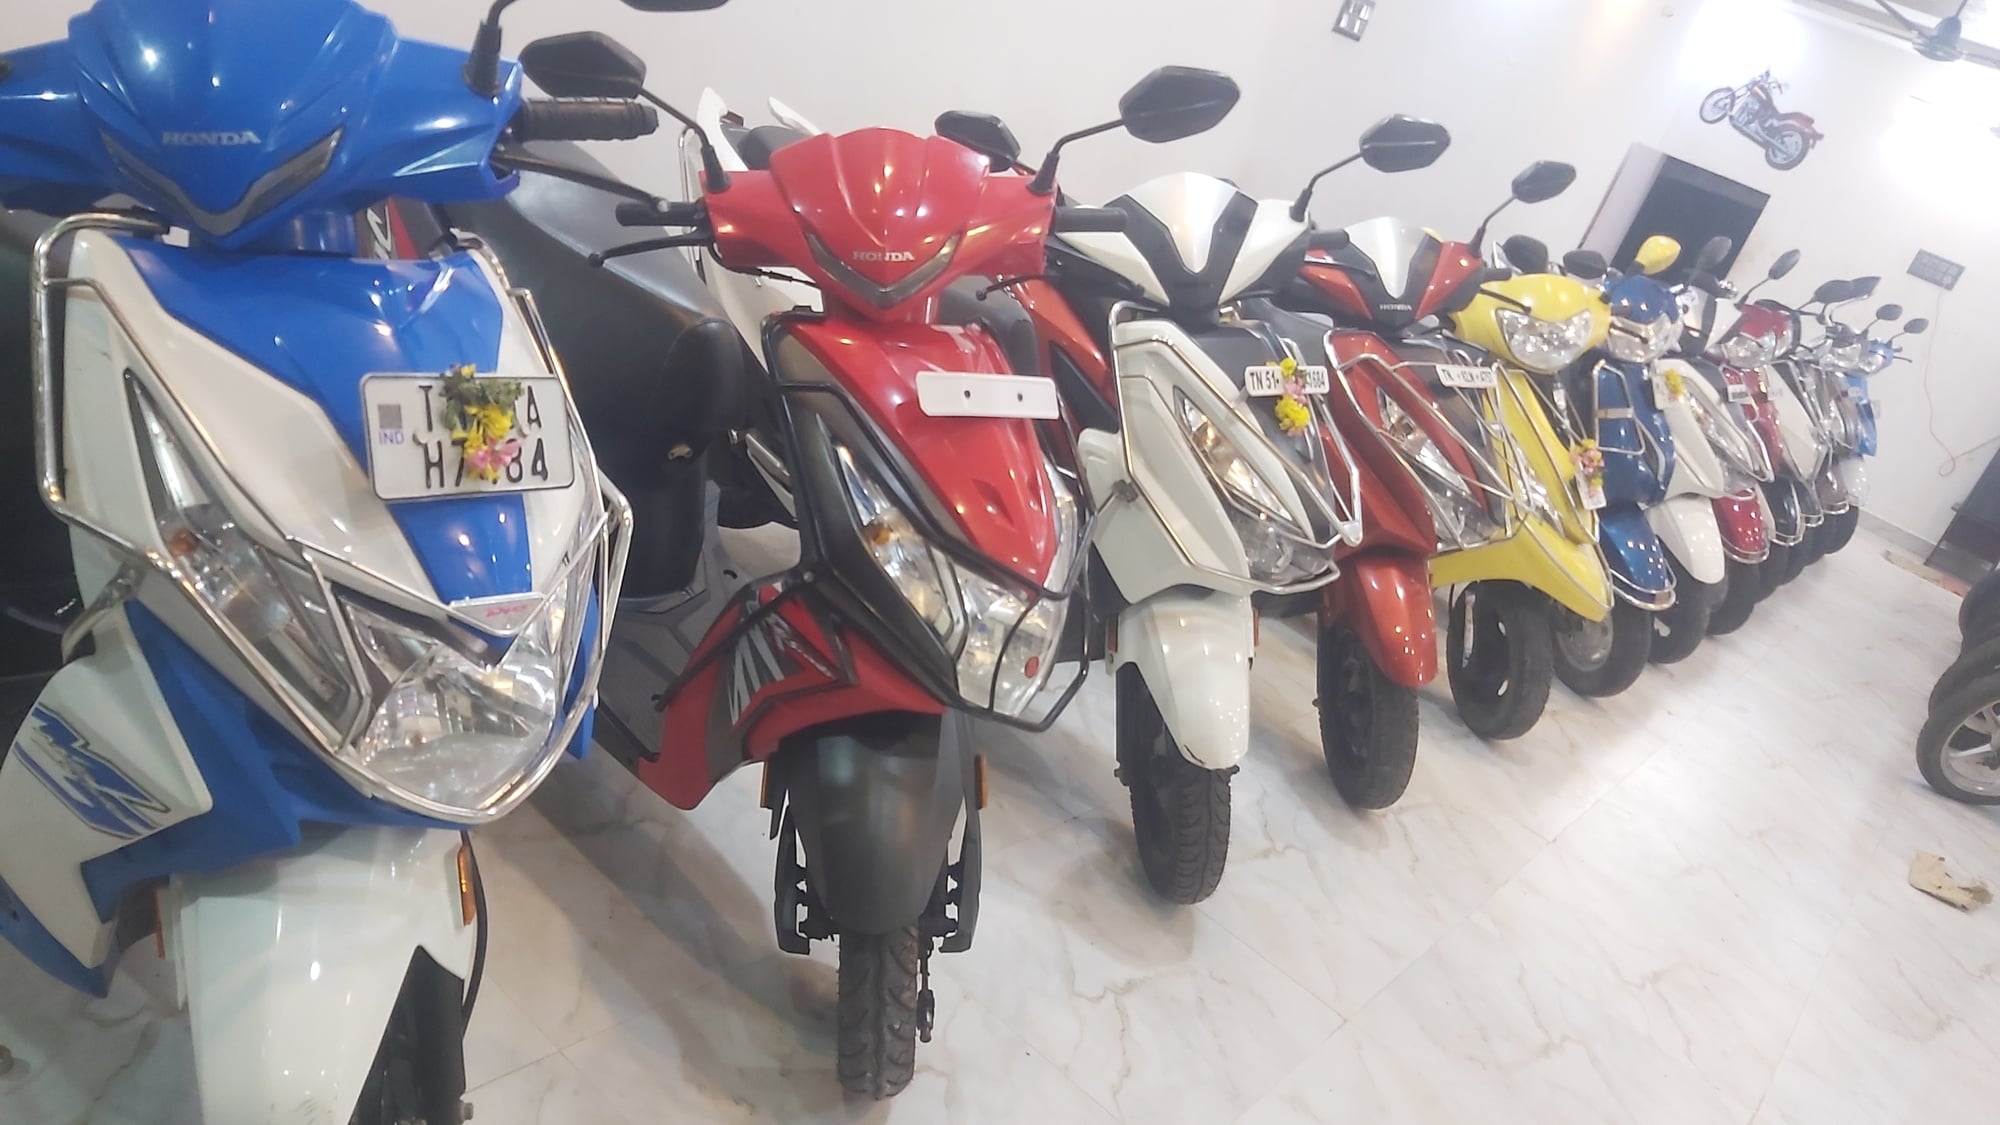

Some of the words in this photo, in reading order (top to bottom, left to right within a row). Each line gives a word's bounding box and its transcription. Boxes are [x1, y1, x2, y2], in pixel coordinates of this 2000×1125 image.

[162, 130, 262, 146] HONDA
[852, 250, 916, 262] HONDA
[1378, 303, 1413, 311] HONDA
[1249, 371, 1264, 391] TN
[379, 431, 405, 445] IND
